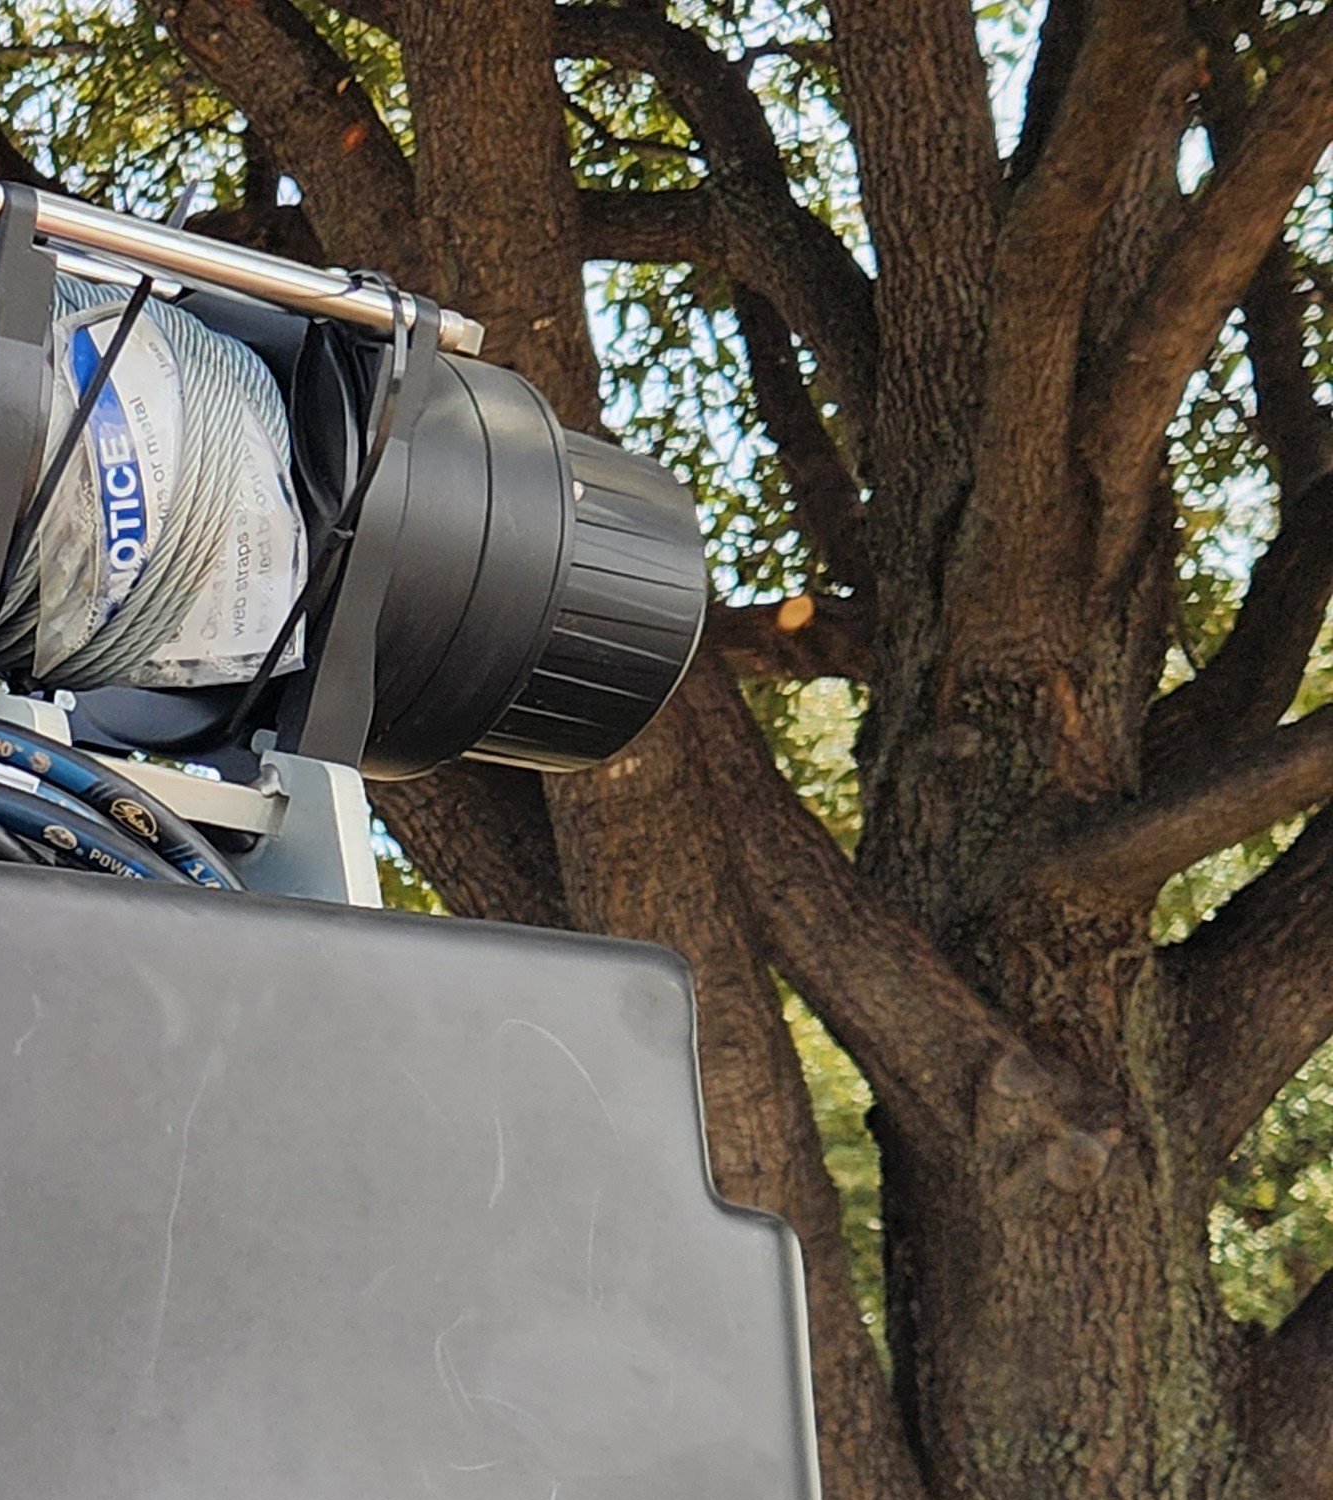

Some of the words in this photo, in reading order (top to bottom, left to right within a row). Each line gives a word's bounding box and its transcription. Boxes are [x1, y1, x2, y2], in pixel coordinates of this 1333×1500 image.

[129, 396, 161, 456] metal
[234, 532, 250, 590] straps
[232, 596, 247, 637] web
